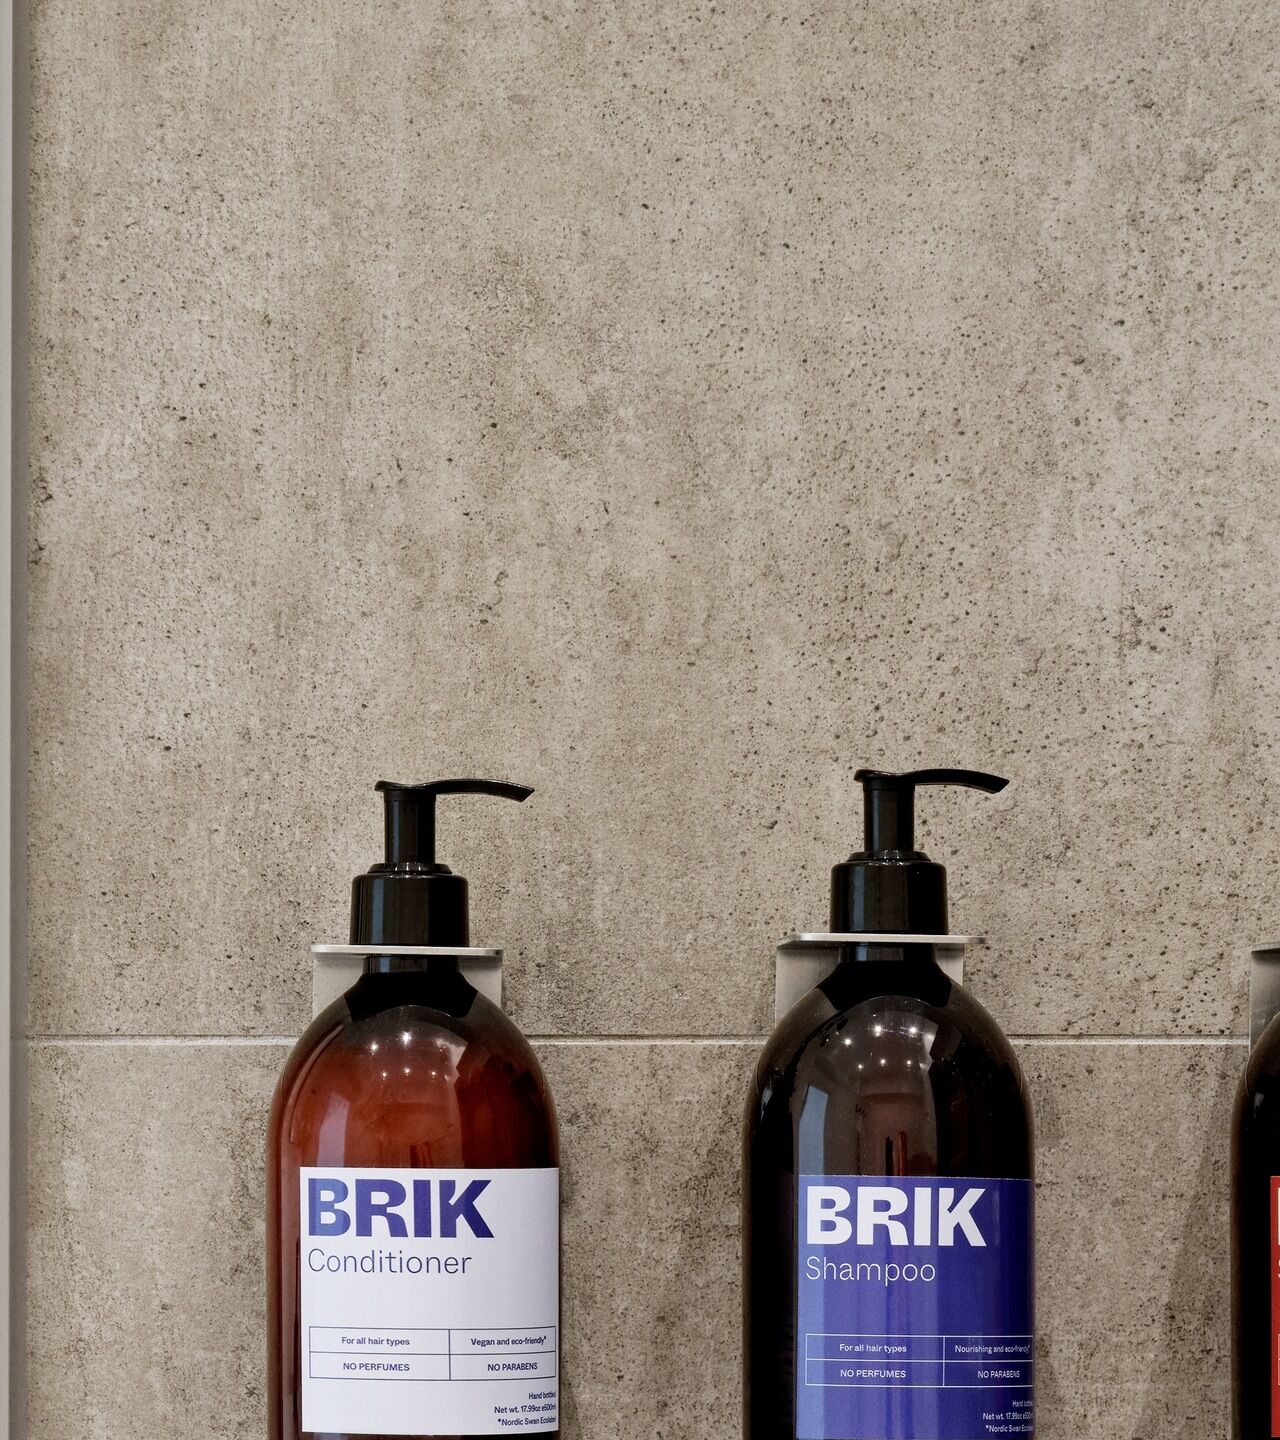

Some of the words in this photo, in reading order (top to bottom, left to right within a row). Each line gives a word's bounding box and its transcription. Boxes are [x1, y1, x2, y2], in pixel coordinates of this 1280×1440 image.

[308, 1178, 494, 1238] BRIK
[806, 1185, 987, 1247] BRIK
[308, 1248, 472, 1274] Conditioner
[806, 1255, 936, 1286] Shampoo
[368, 1337, 384, 1345] hair
[386, 1338, 410, 1346] types
[471, 1338, 495, 1347] Vegan
[839, 1344, 853, 1352] For
[854, 1344, 864, 1352] all
[866, 1344, 883, 1352] hair
[884, 1345, 907, 1354] types
[954, 1345, 992, 1354] Nourishing
[993, 1345, 1004, 1353] and
[343, 1362, 357, 1370] NO
[359, 1363, 410, 1371] PERFUMES
[488, 1363, 500, 1371] NO
[502, 1362, 538, 1371] PARABENS
[840, 1369, 854, 1377] NO
[856, 1370, 906, 1378] PERFUMES
[977, 1370, 990, 1378] NO
[990, 1370, 1020, 1378] PARABENS
[528, 1392, 542, 1400] Hand
[983, 1412, 995, 1420] Net
